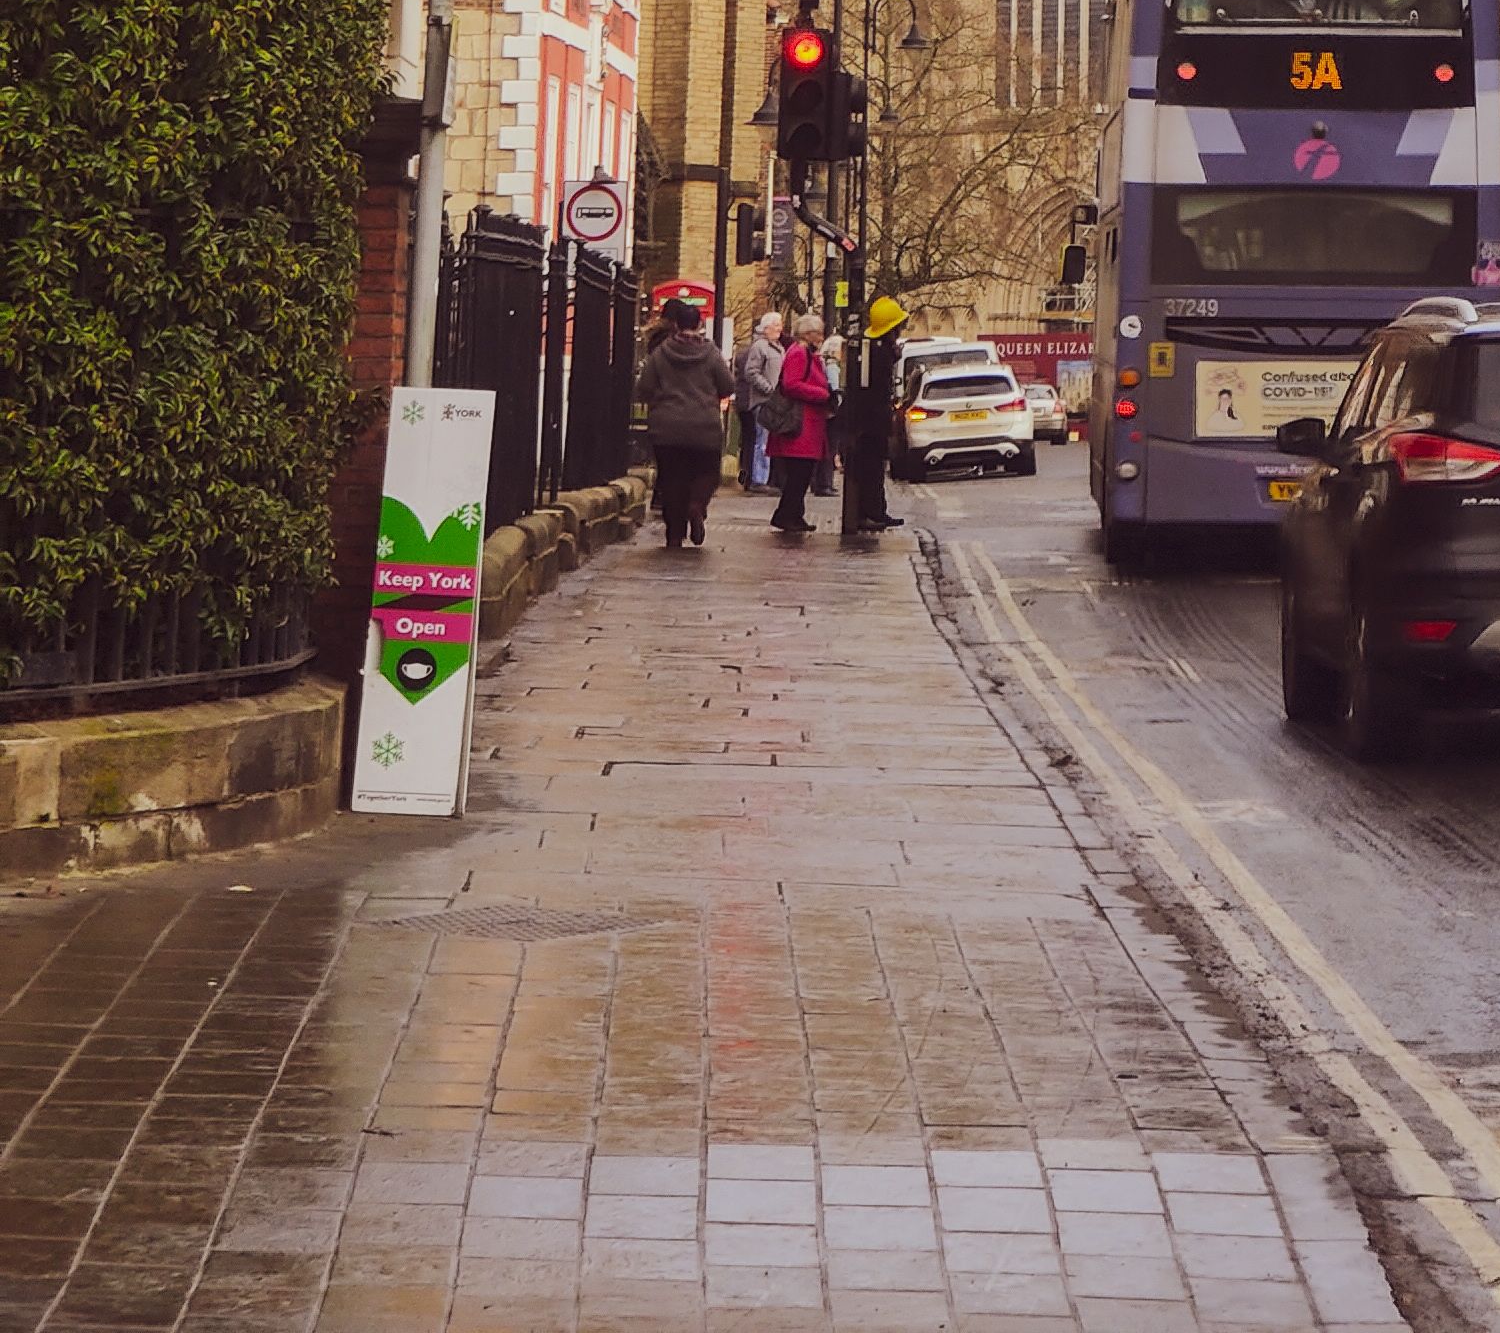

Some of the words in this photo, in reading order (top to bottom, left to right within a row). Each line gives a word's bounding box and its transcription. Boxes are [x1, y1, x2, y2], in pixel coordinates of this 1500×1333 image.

[1290, 52, 1343, 90] 5A
[1166, 299, 1219, 318] 37249
[997, 342, 1042, 357] QUEEN
[1261, 371, 1328, 383] Confused
[454, 409, 482, 418] YORK
[378, 570, 424, 592] Keep
[428, 572, 471, 590] York
[395, 617, 446, 639] Open
